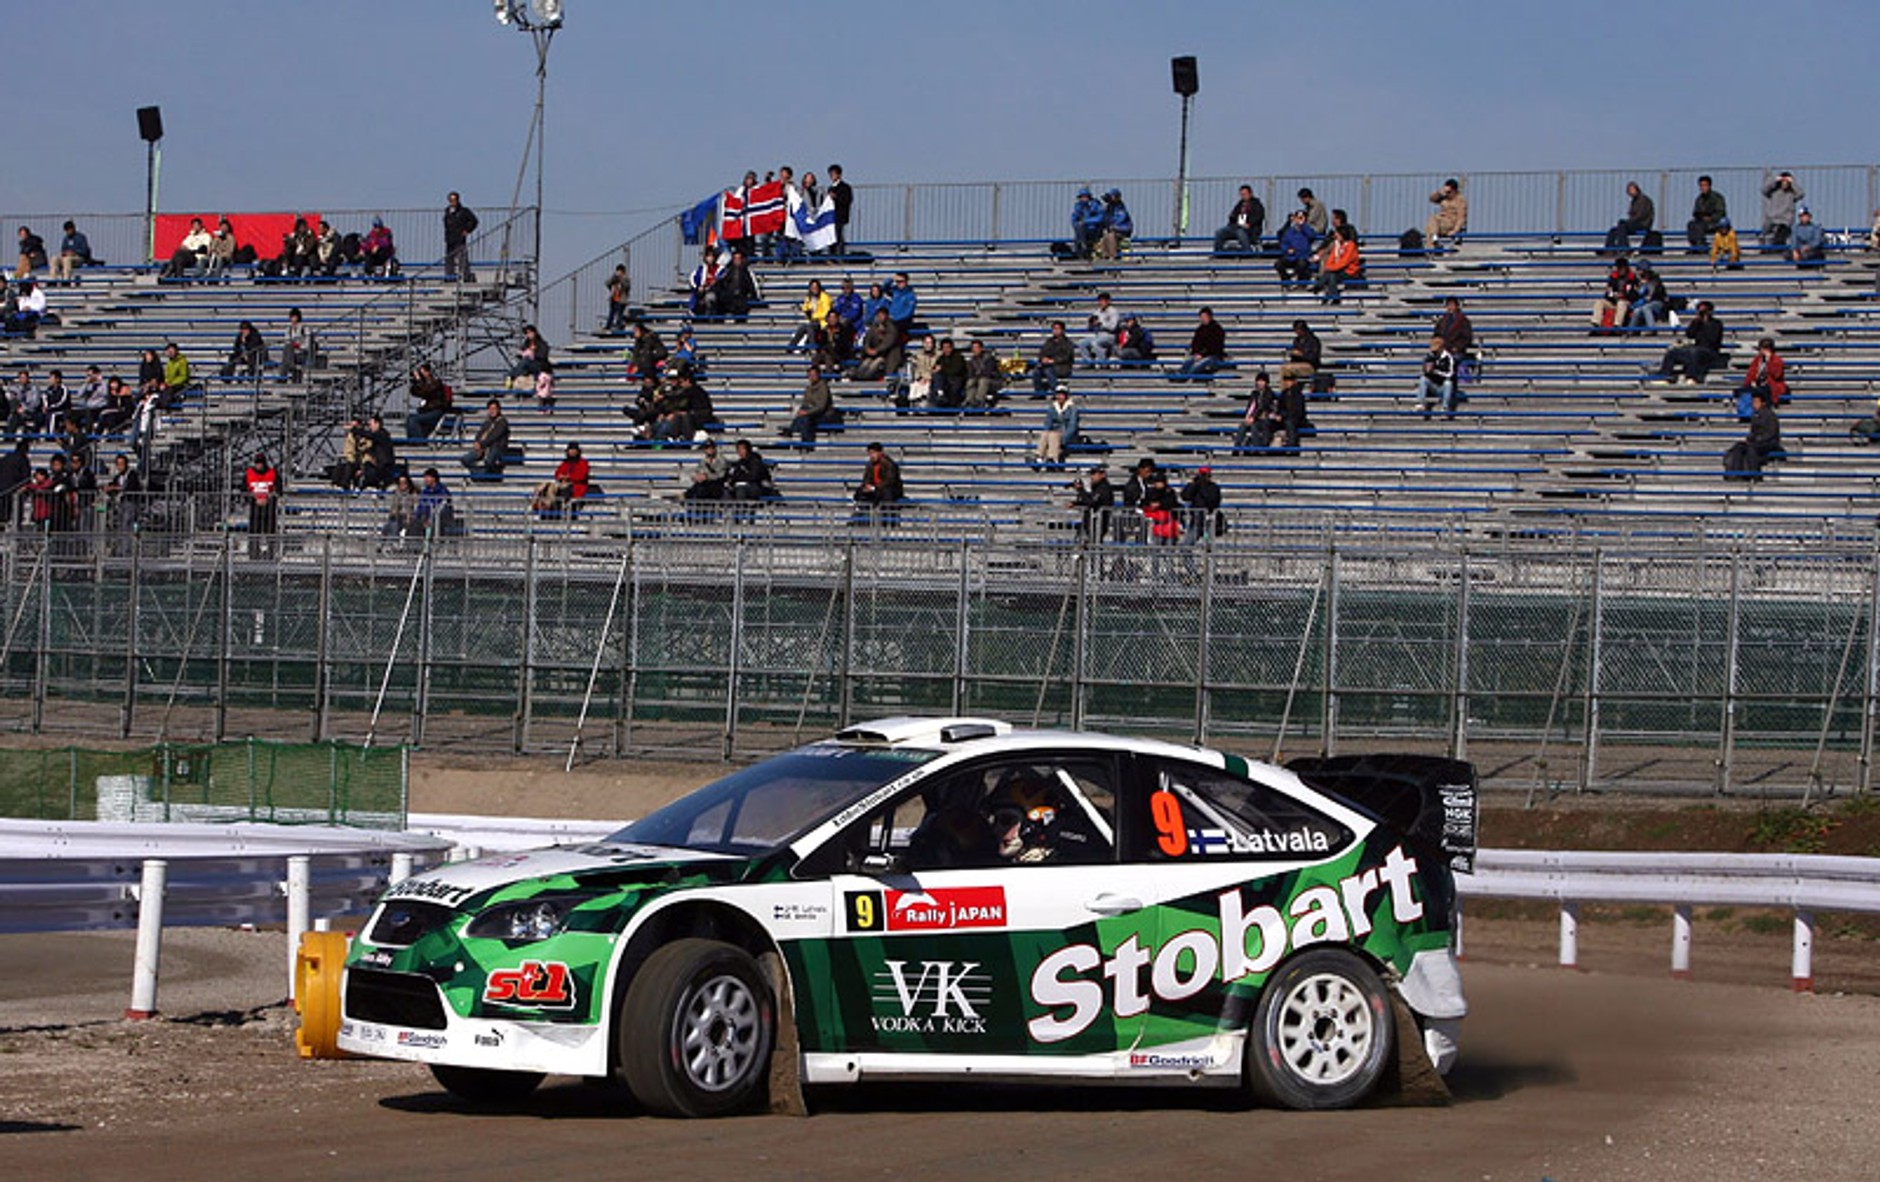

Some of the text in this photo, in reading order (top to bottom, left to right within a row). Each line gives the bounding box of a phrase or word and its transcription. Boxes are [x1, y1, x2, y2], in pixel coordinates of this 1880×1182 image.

[1151, 790, 1187, 857] 9
[1231, 826, 1329, 853] Latvala
[856, 895, 873, 928] 9
[906, 908, 946, 924] Rally
[1028, 846, 1423, 1043] Stobart
[884, 959, 981, 1019] VK
[871, 1016, 987, 1033] VODKA KICK
